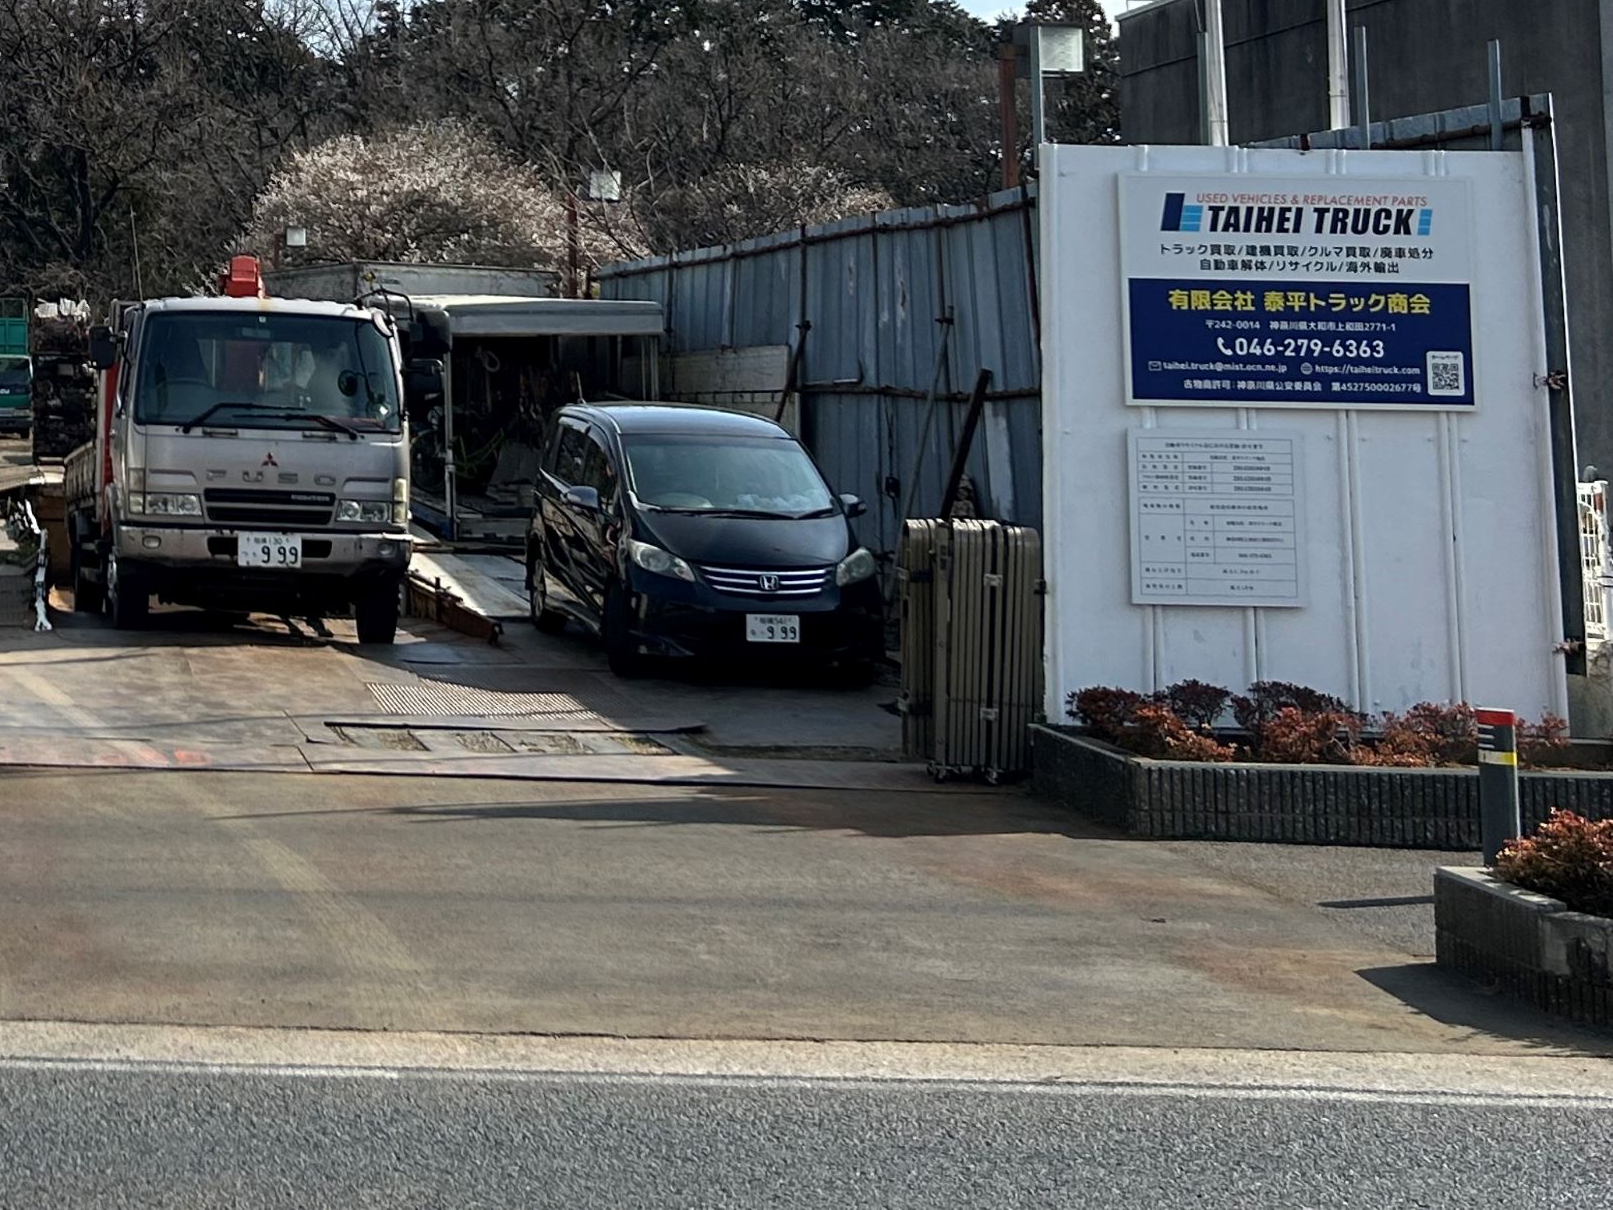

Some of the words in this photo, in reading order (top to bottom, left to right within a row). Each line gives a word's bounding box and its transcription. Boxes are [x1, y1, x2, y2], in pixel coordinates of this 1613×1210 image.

[1196, 193, 1229, 204] USED
[1231, 194, 1287, 205] VEHICLES
[1290, 195, 1299, 205] &
[1303, 195, 1388, 206] REPLACEMENT
[1391, 196, 1428, 207] PARTS
[1208, 205, 1304, 234] TAIHEI
[1313, 207, 1415, 236] TRUCK
[1168, 290, 1256, 311] 有限会社
[1263, 291, 1431, 315] 泰平トラック商会
[1235, 338, 1384, 357] 046-279-6363
[206, 469, 337, 487] FUSO
